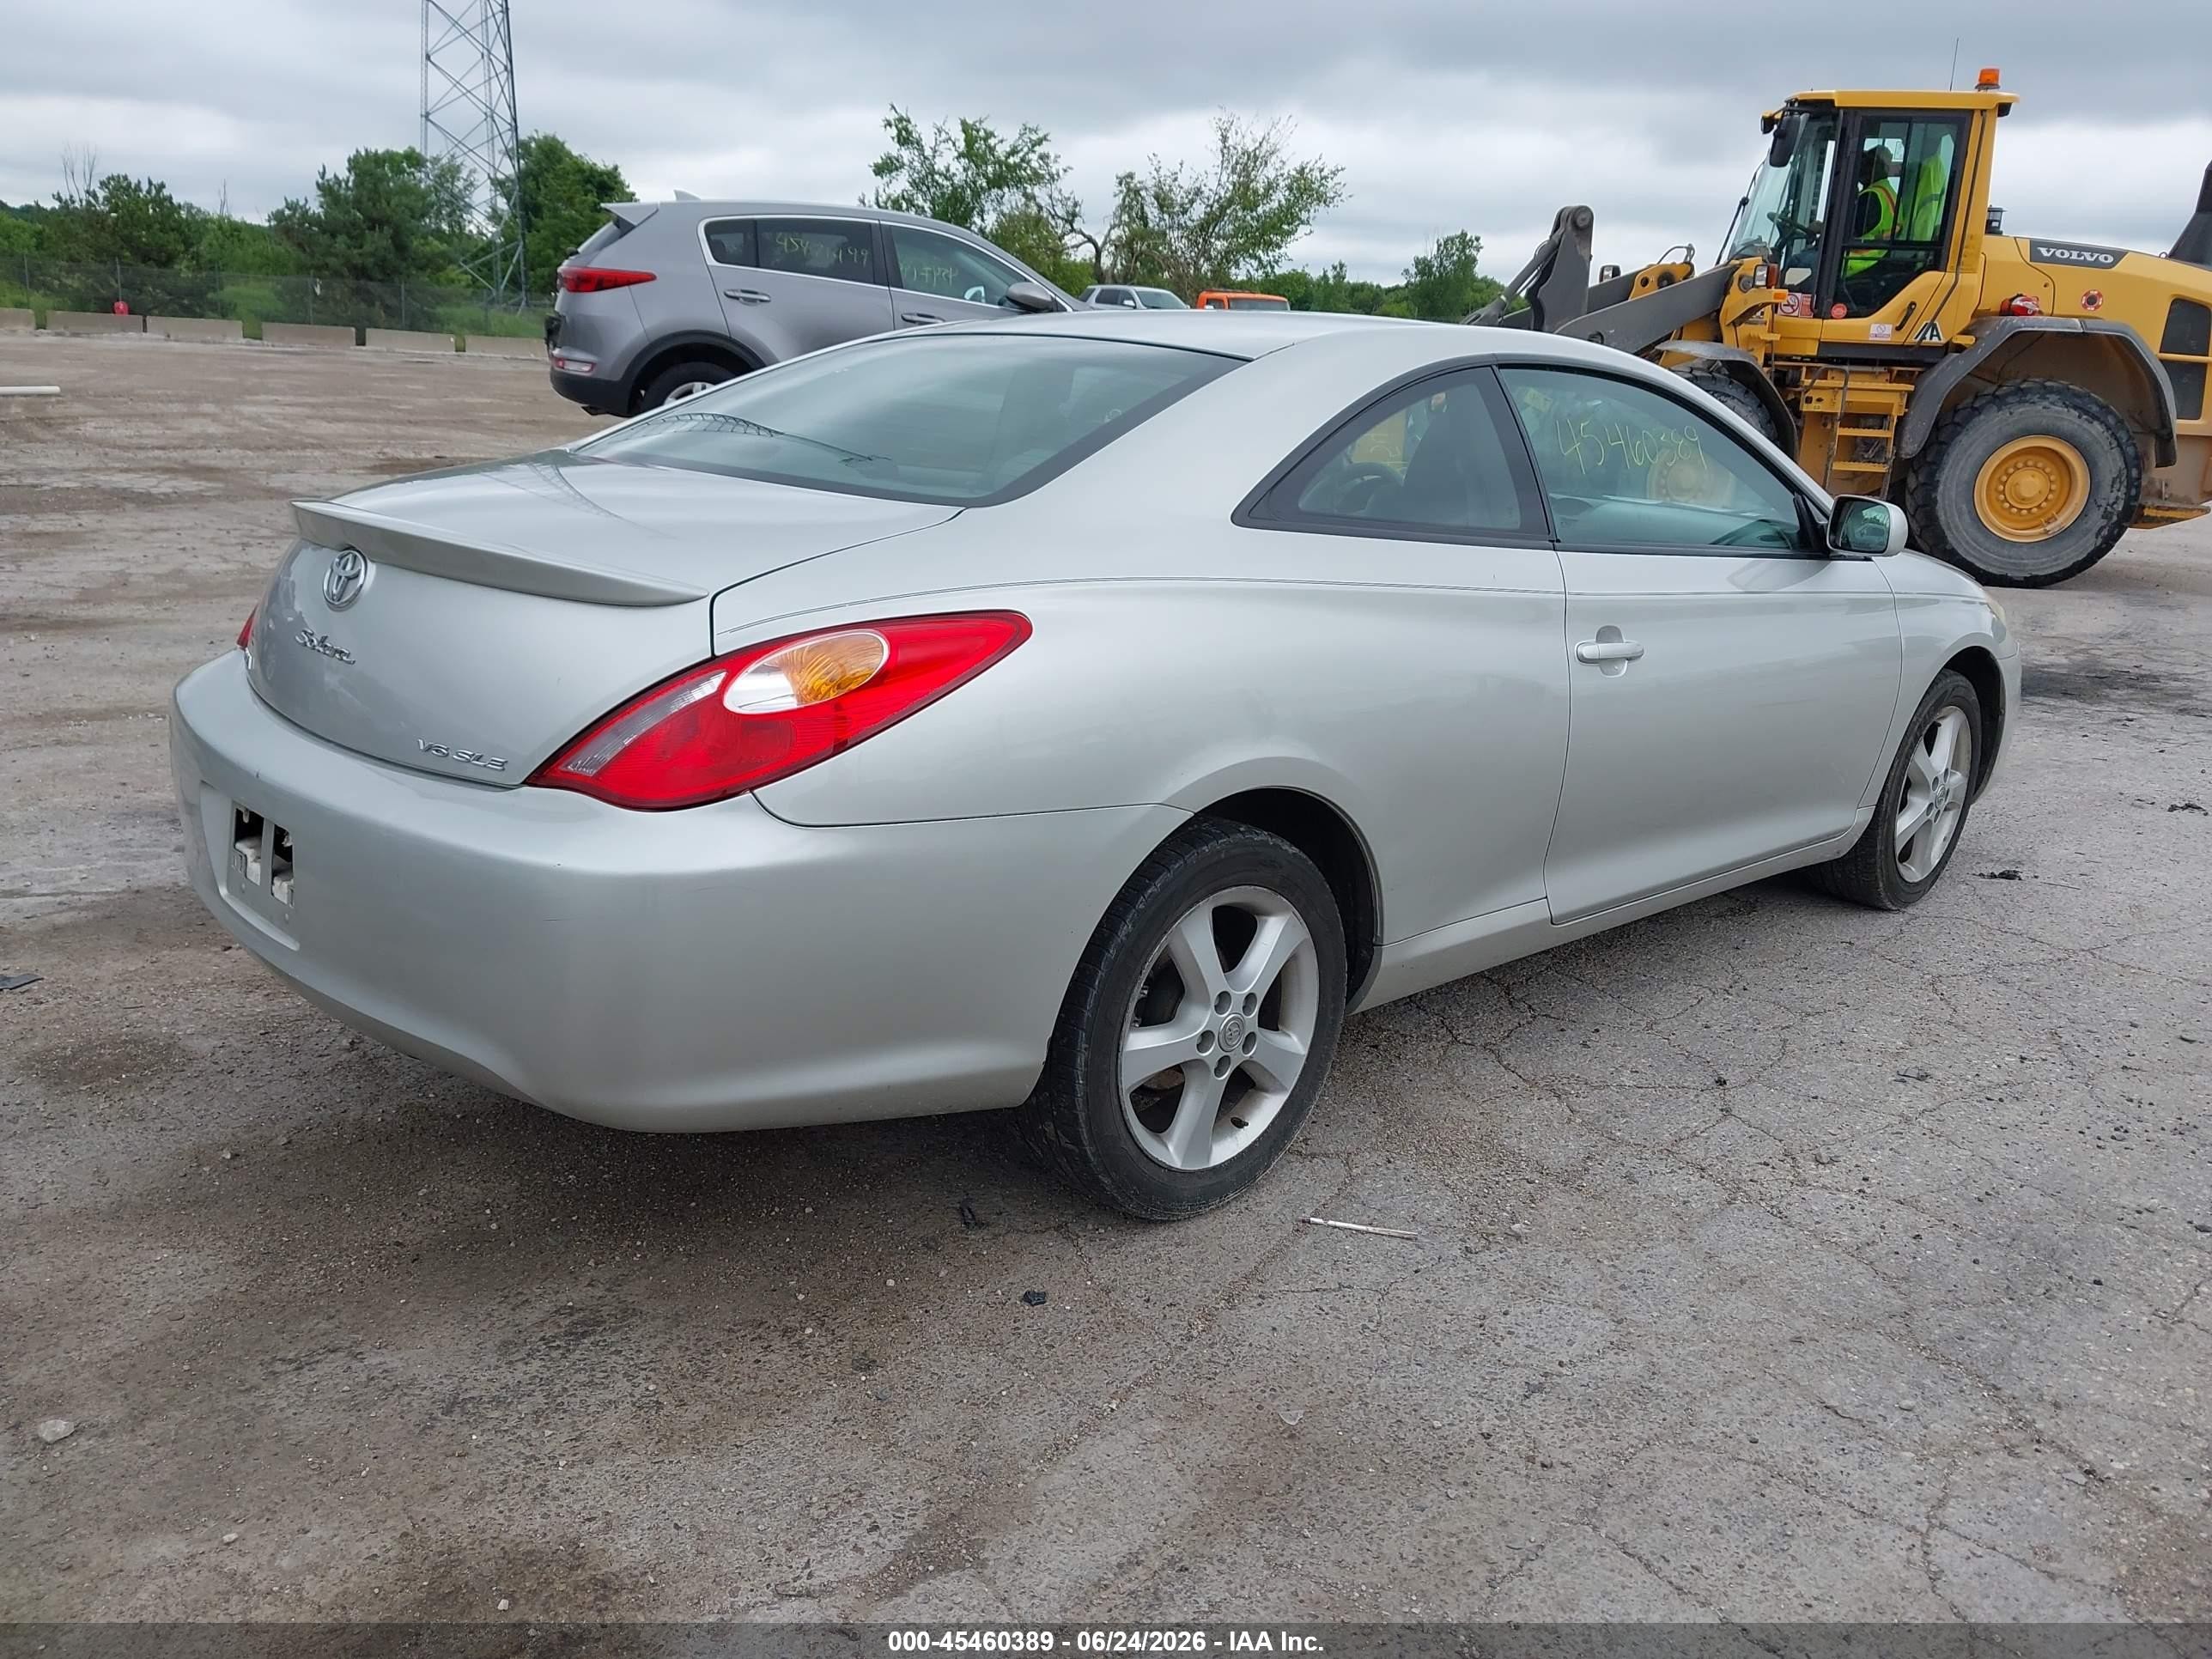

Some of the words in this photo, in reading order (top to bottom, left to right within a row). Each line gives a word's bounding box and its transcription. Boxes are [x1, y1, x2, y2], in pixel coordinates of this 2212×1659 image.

[2037, 246, 2114, 264] VOLVO
[1556, 418, 1708, 475] 45460389
[417, 738, 450, 757] V6
[453, 750, 508, 771] SLE
